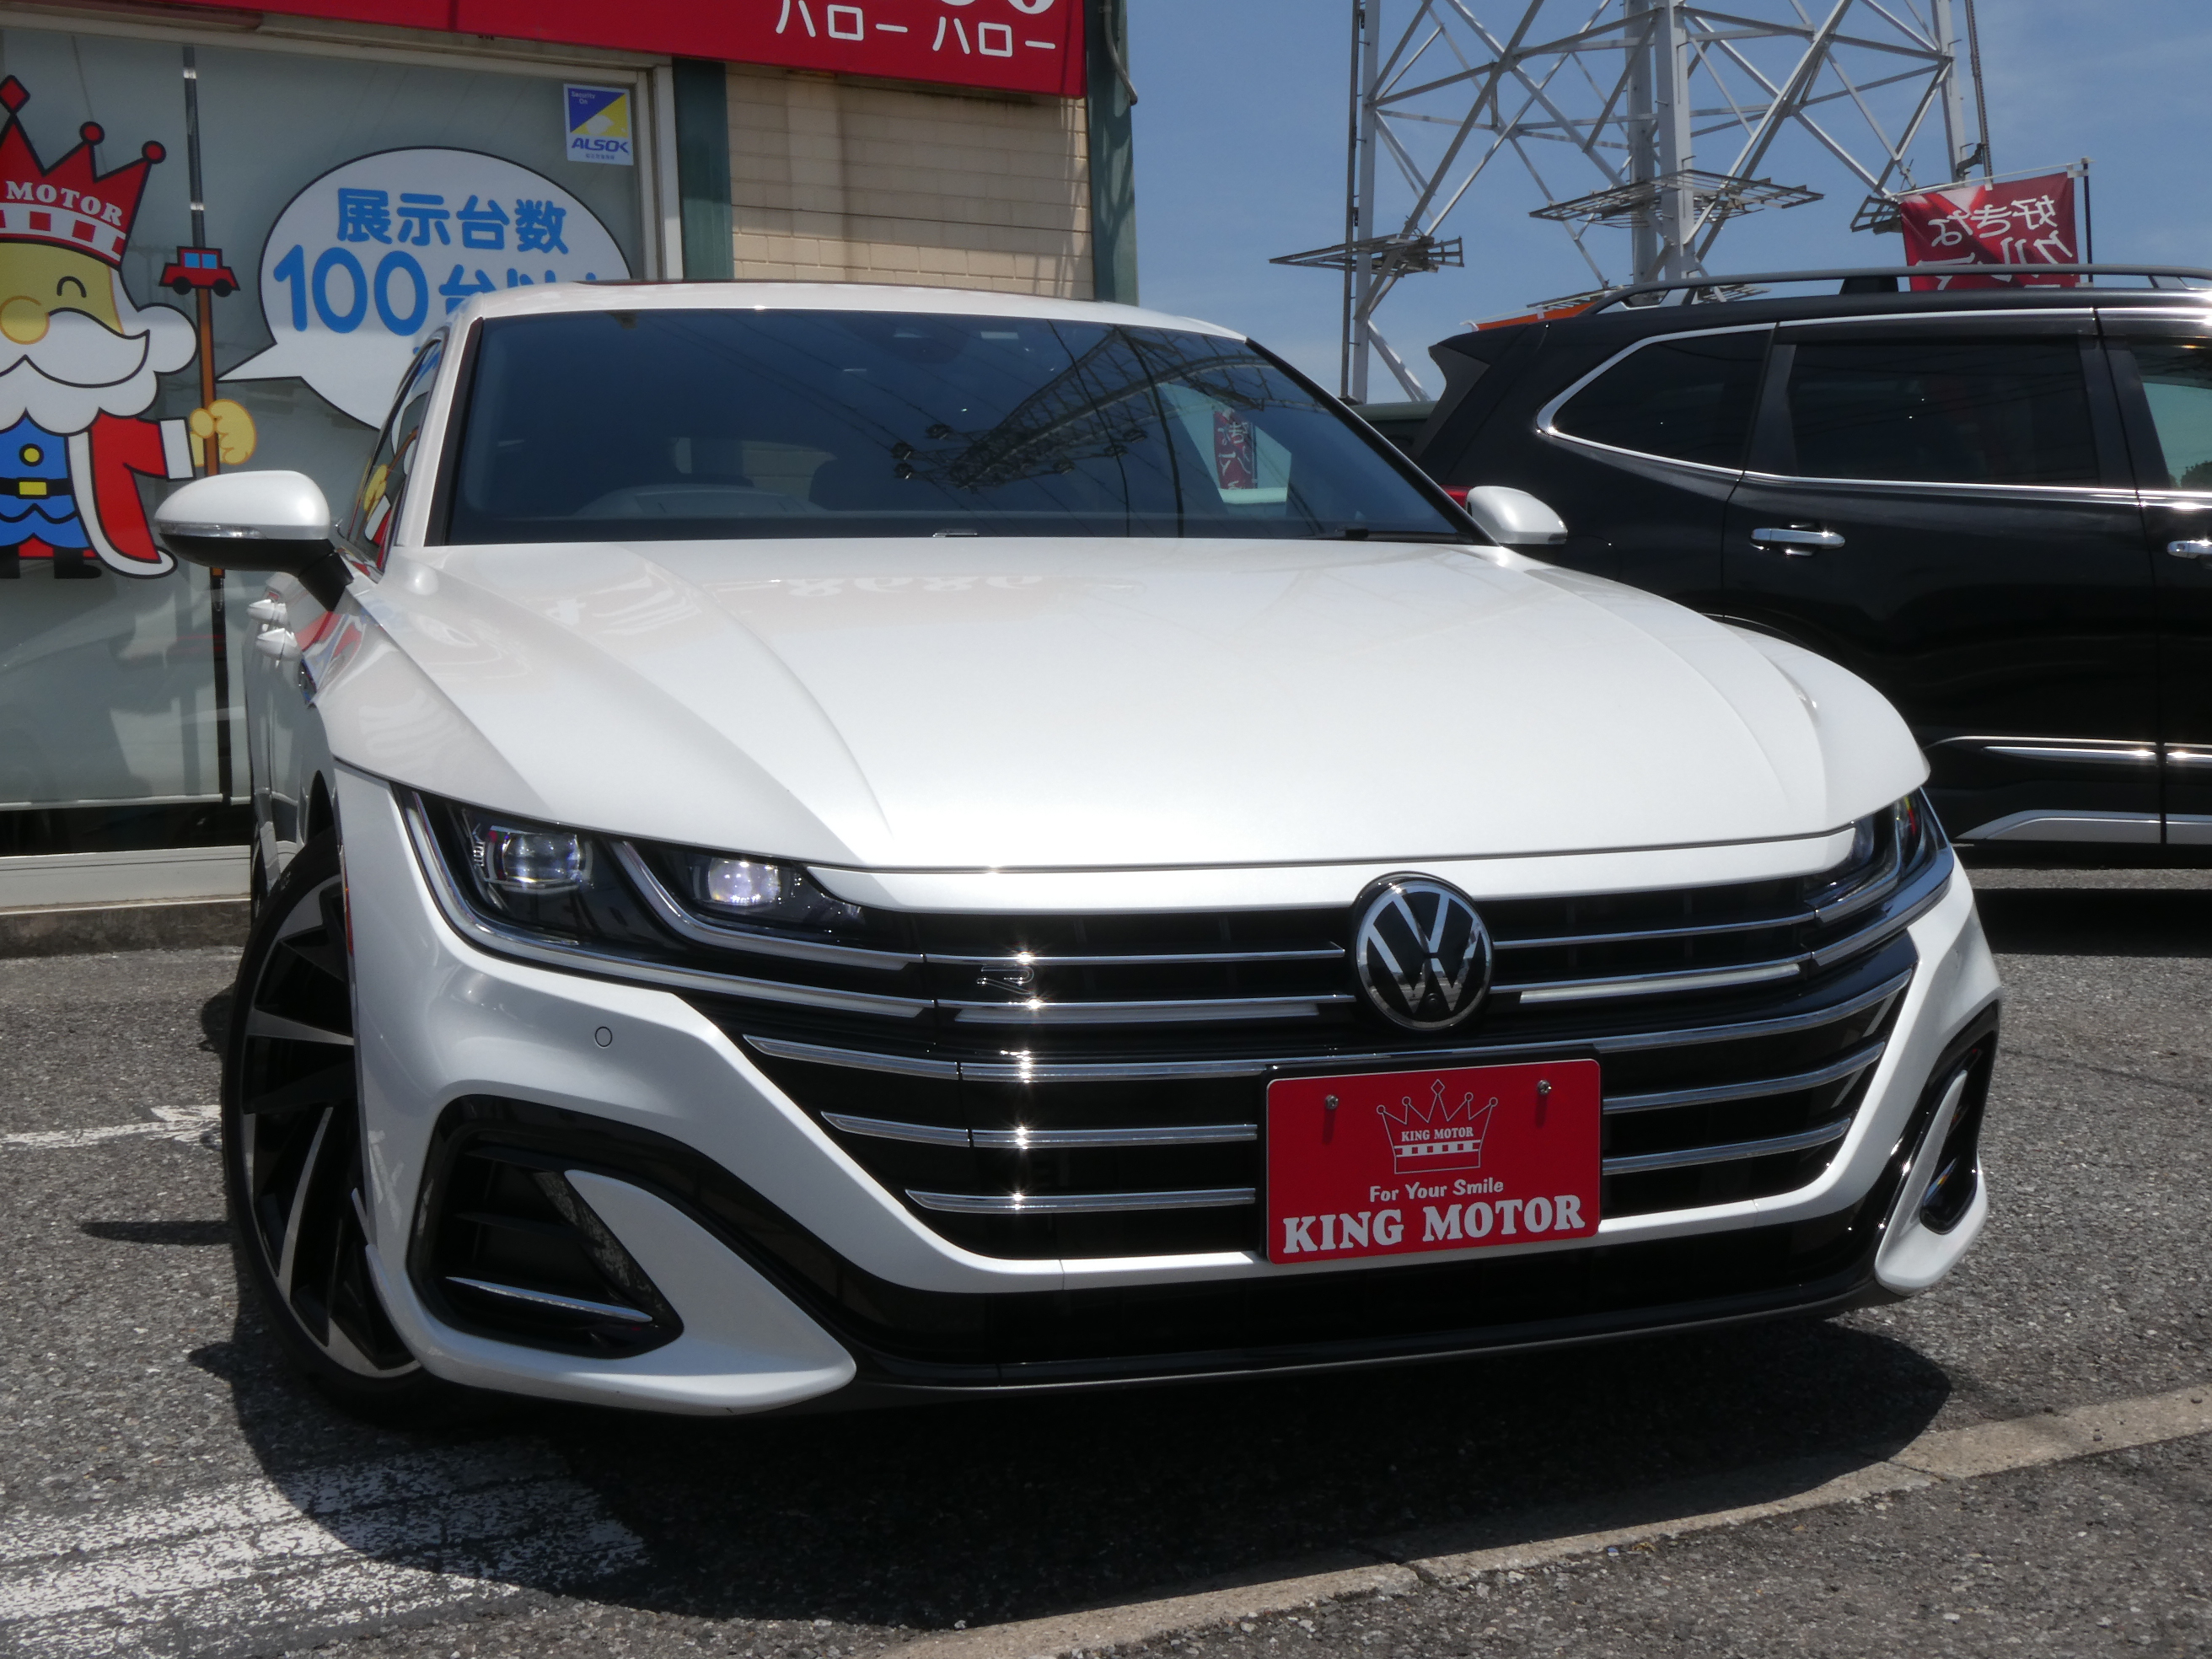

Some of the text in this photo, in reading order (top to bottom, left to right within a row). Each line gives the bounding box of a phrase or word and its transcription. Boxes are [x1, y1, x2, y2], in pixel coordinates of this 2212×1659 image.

[776, 0, 1055, 57] ハロー ハロー
[572, 137, 629, 154] ALSOK
[6, 180, 122, 226] MOTOR
[337, 187, 569, 255] 展示台数
[1401, 1126, 1474, 1142] KING MOTOR
[1369, 1177, 1505, 1203] For Your Smile
[1282, 1195, 1586, 1254] KING MOTOR
